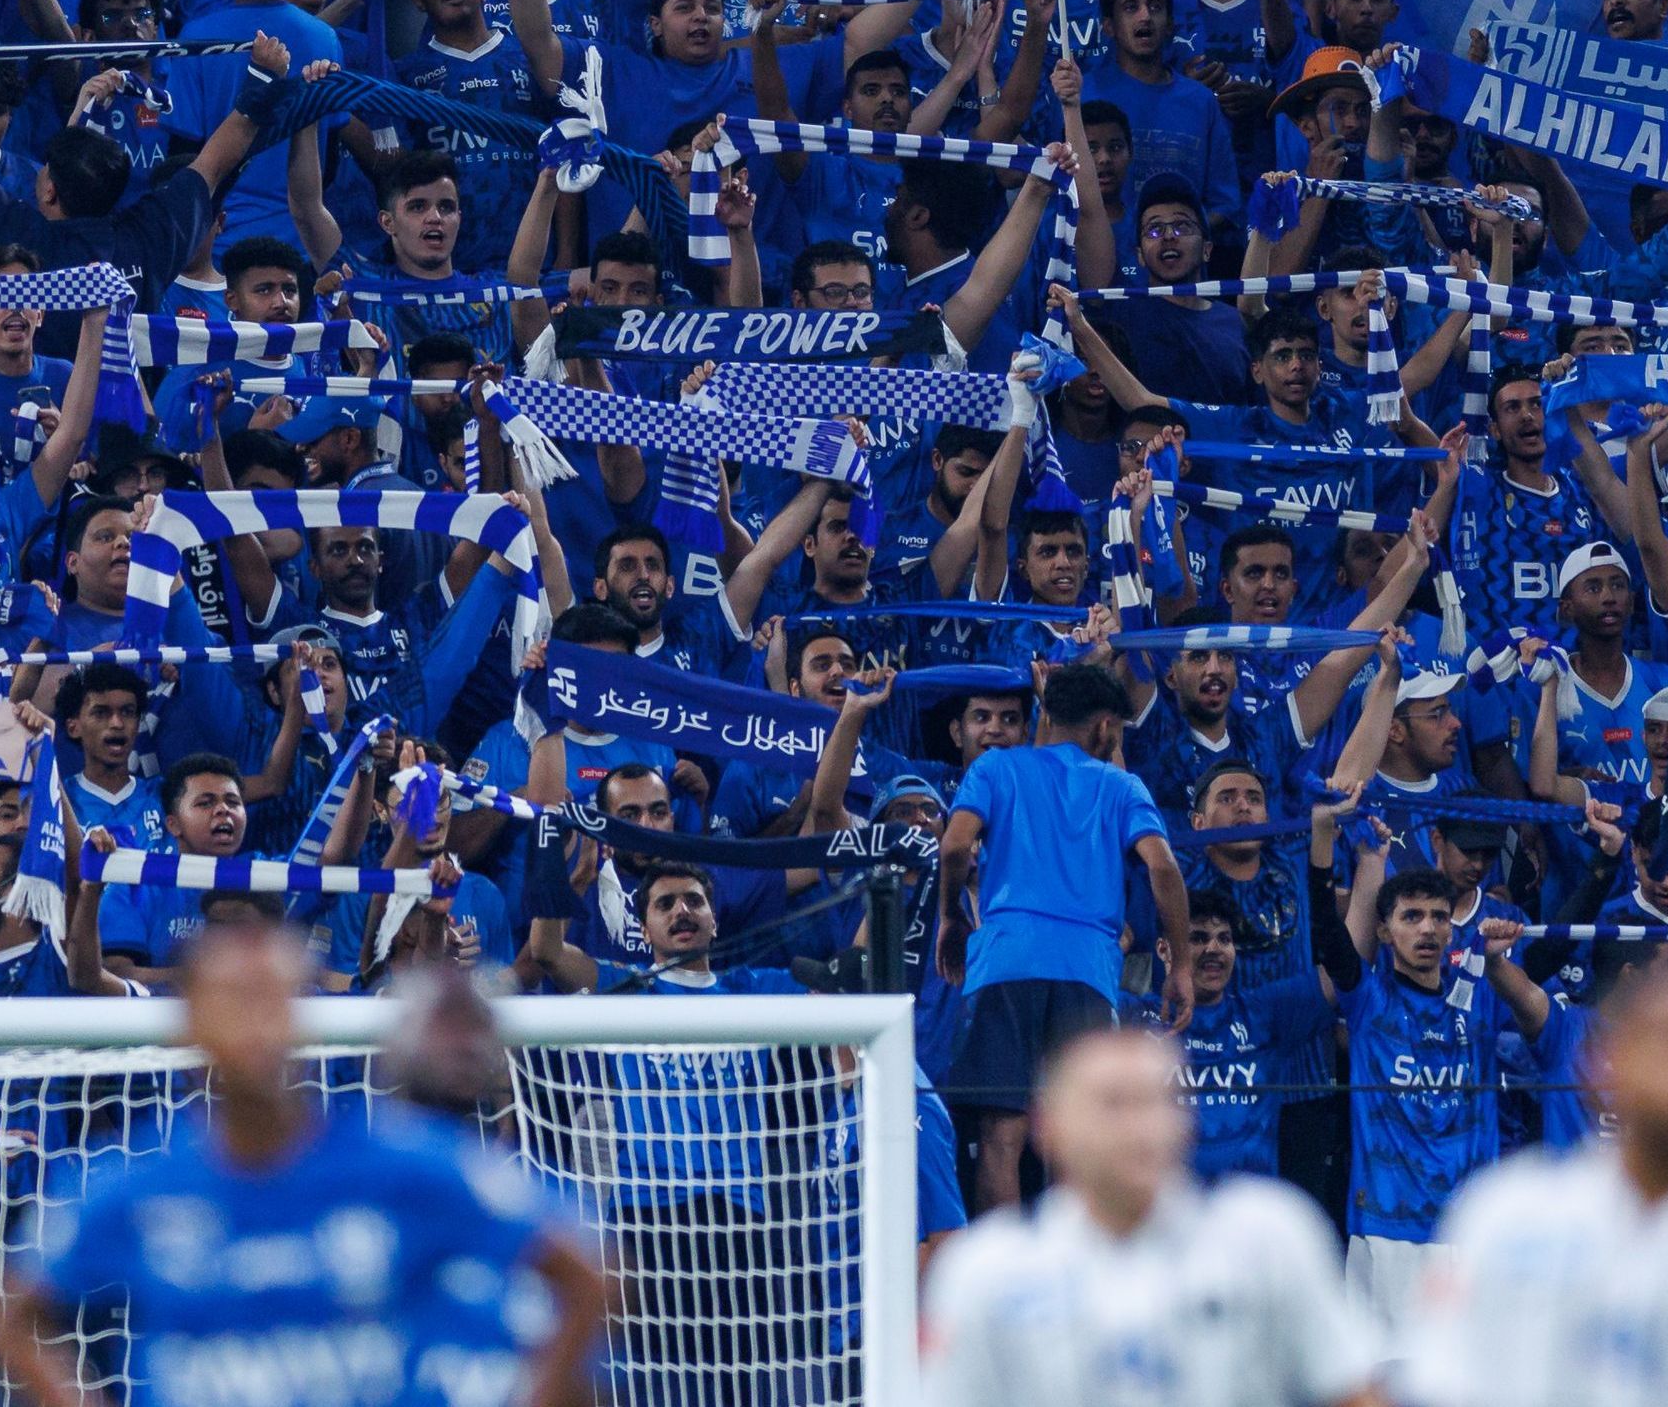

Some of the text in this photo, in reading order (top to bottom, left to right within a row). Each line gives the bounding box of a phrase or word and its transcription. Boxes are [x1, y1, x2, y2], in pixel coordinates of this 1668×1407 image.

[427, 126, 489, 154] SAV
[614, 308, 881, 355] BLUE POWER
